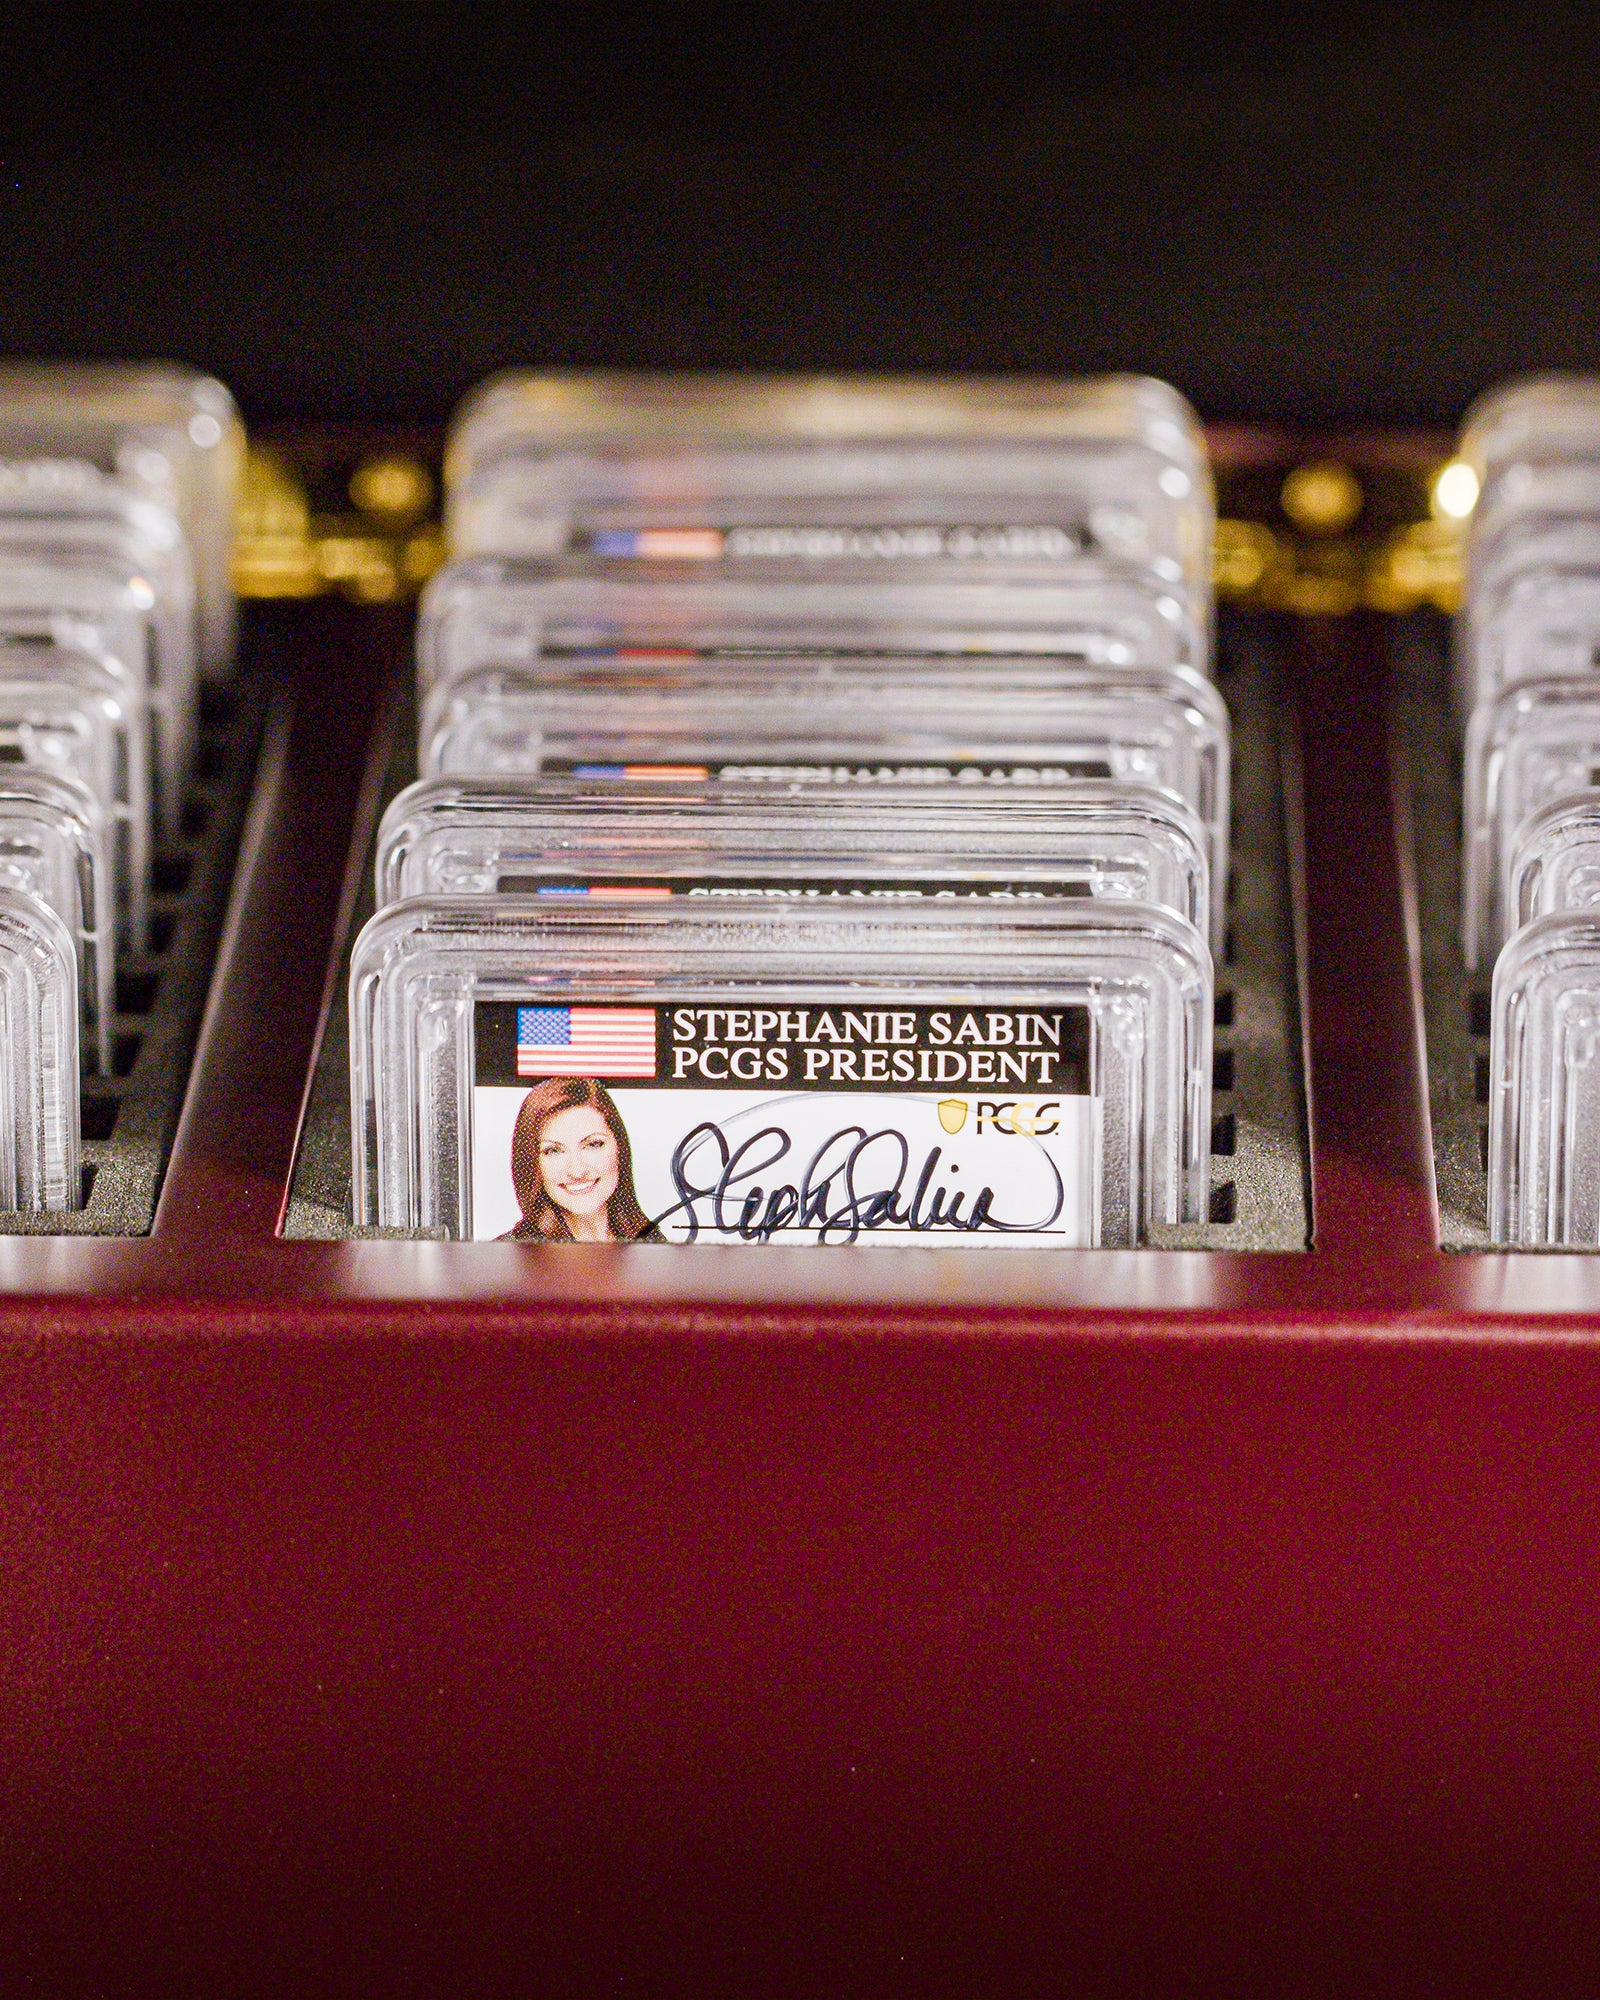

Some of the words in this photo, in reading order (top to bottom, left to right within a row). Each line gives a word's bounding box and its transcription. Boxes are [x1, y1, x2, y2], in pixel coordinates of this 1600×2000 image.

[672, 1008, 917, 1045] STEPHANIE
[927, 1012, 1064, 1047] SABIN
[671, 1046, 789, 1081] PCGS
[802, 1048, 1060, 1084] PRESIDENT
